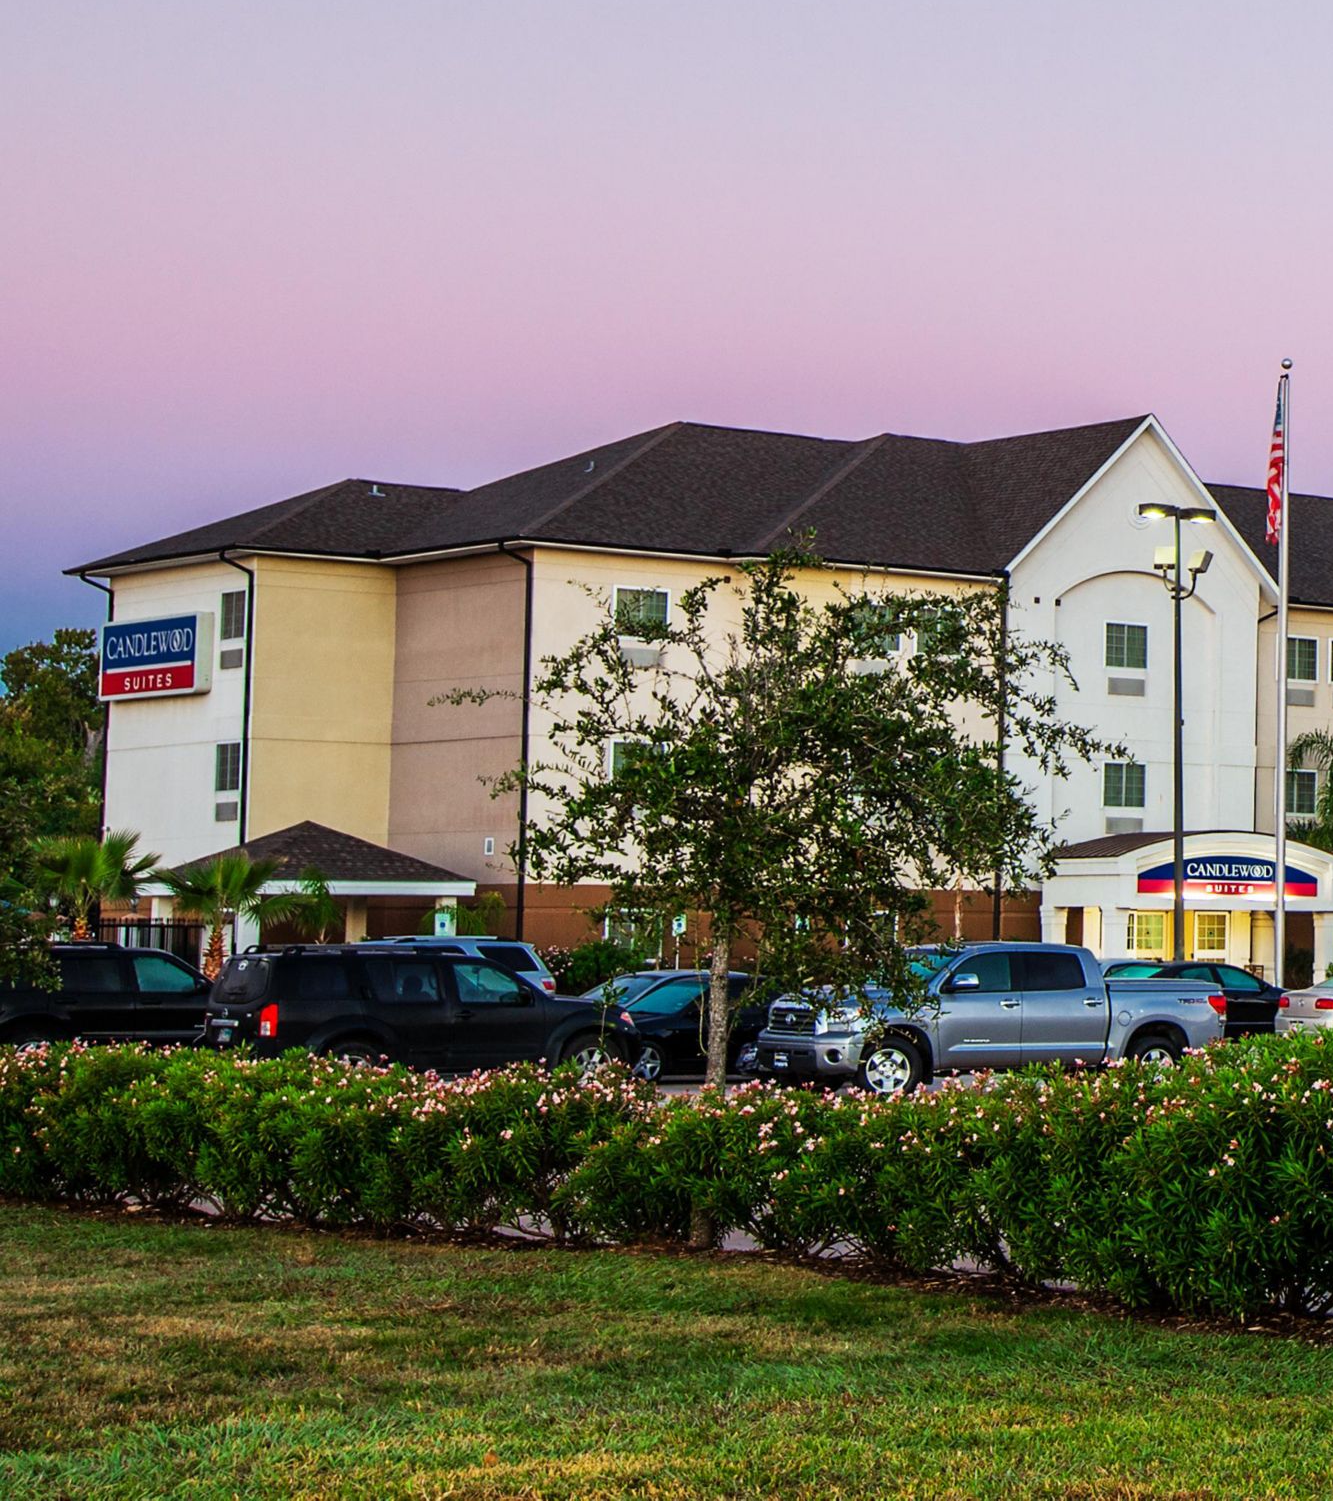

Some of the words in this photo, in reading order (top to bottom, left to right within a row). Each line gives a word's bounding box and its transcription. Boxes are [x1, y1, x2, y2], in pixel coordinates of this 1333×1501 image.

[106, 627, 193, 660] CANDLEWOOD
[123, 673, 173, 691] SUITES
[1186, 863, 1274, 878] CANDLEWOOD
[1205, 884, 1255, 893] SUITES
